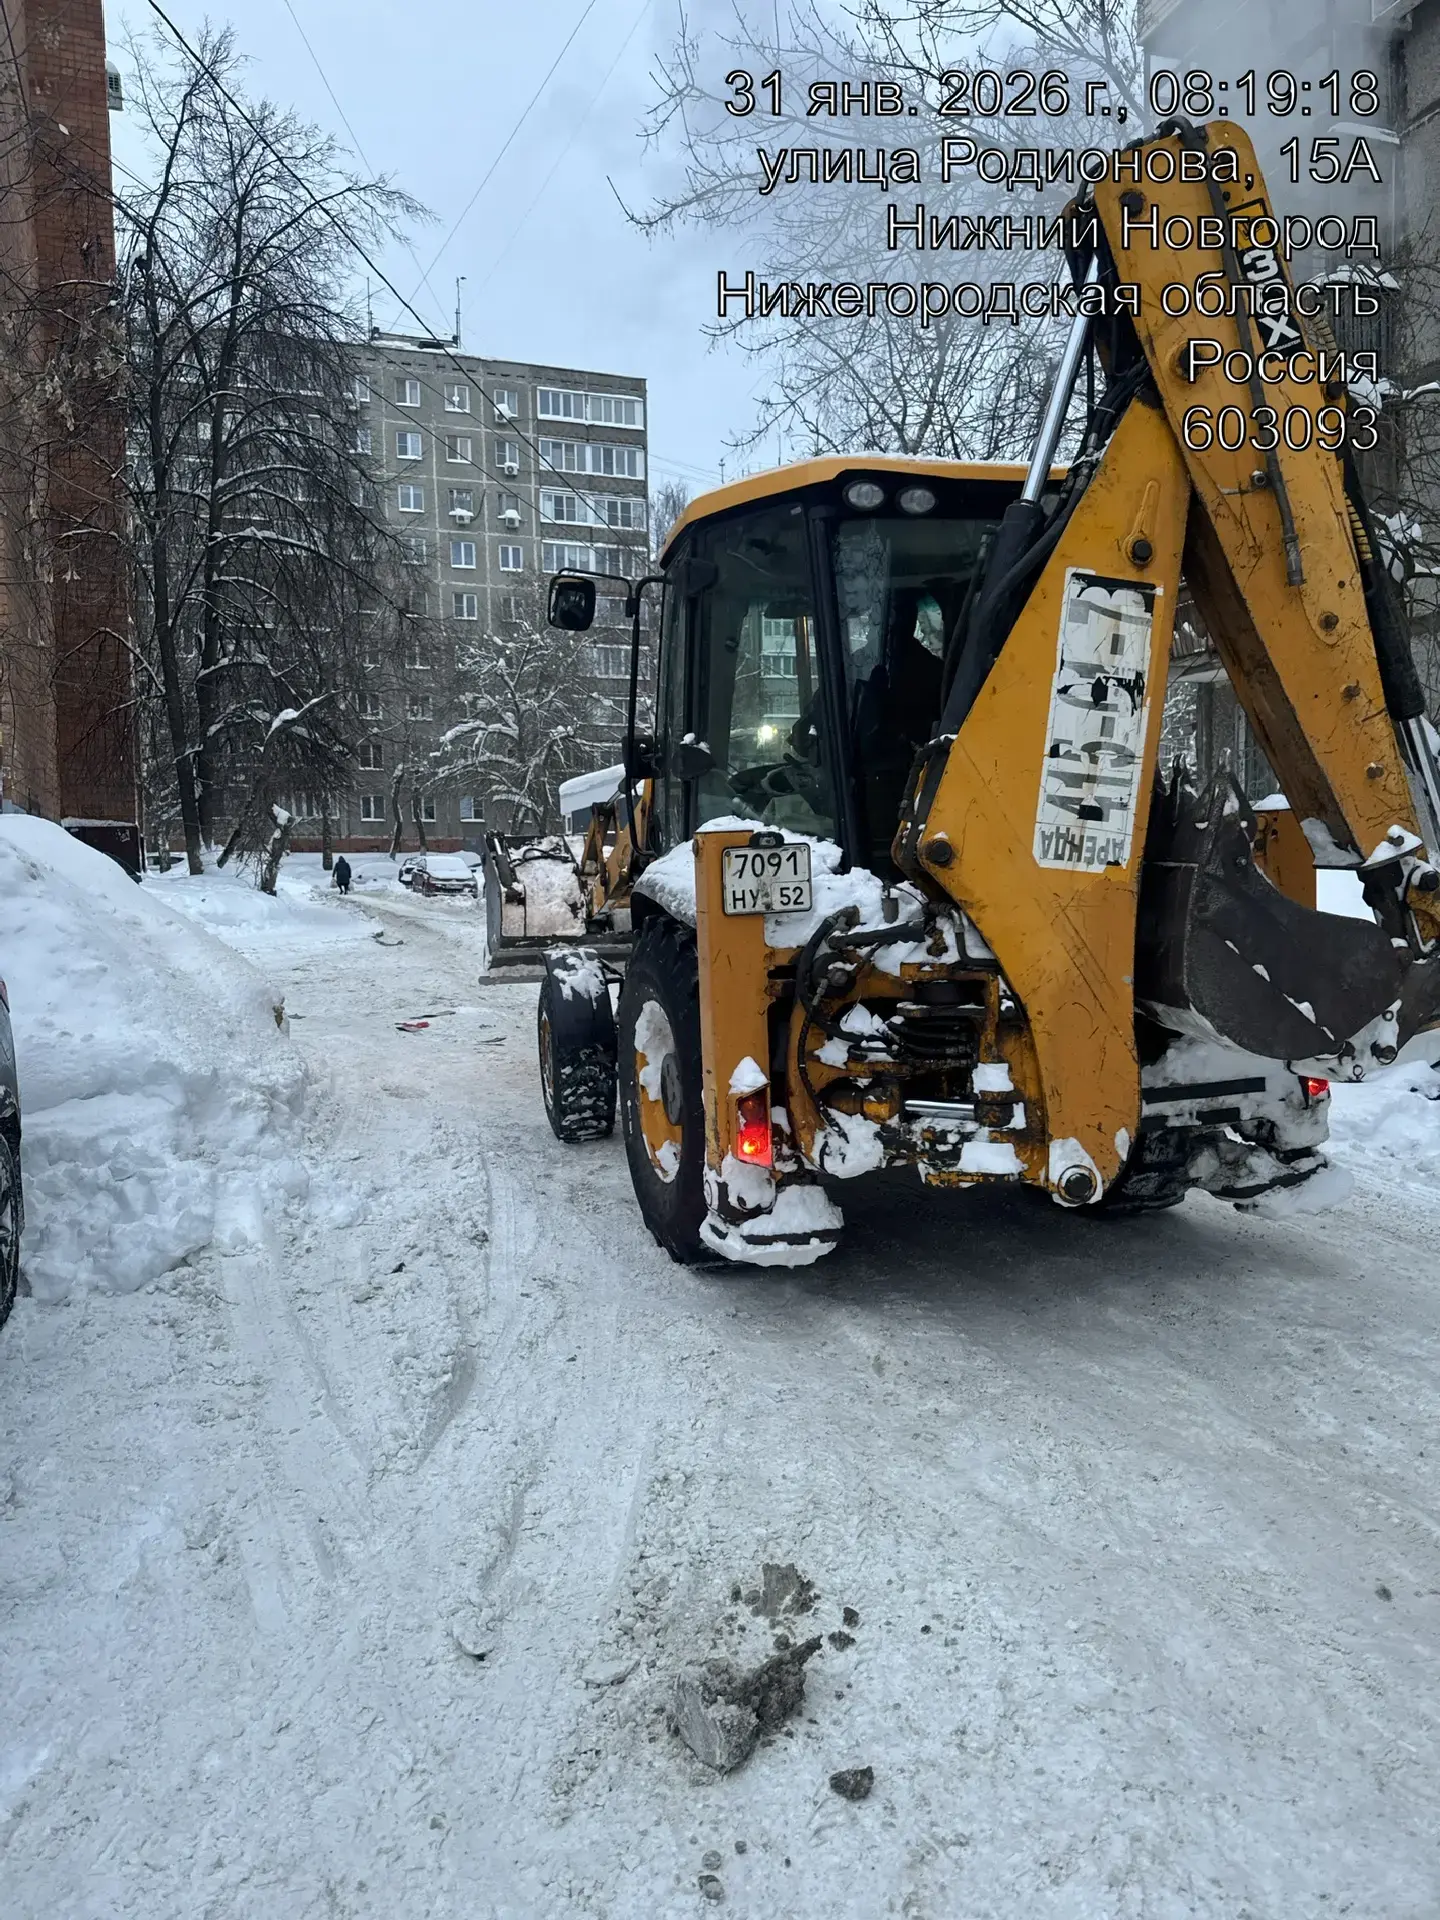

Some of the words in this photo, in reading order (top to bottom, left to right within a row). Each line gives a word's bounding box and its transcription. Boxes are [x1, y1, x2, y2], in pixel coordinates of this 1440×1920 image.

[1040, 827, 1125, 866] АРЕНДА
[734, 851, 798, 879] 7091
[780, 886, 804, 906] 52
